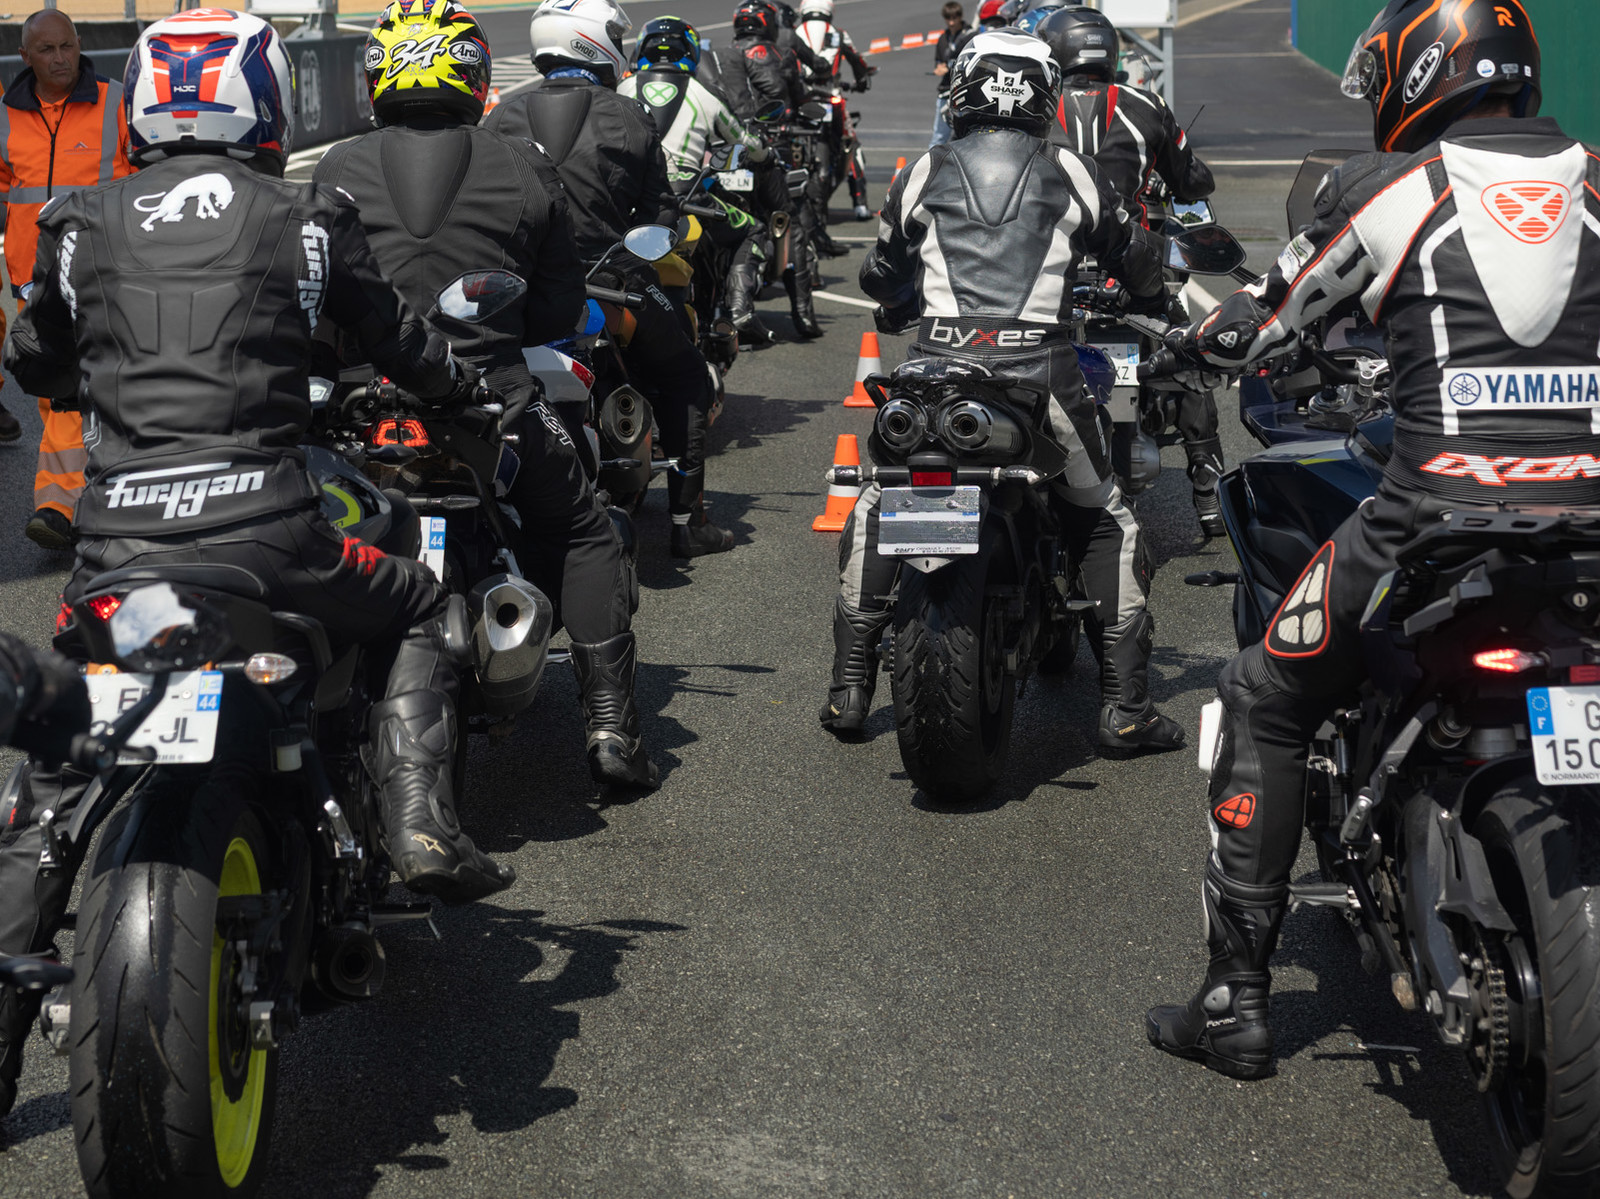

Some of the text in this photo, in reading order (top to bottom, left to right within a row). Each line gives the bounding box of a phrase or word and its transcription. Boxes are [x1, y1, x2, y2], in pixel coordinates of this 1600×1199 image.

[386, 34, 449, 79] 34
[452, 45, 479, 59] Arai
[573, 40, 596, 60] SHOEI
[1406, 49, 1437, 96] HJC
[990, 85, 1025, 96] SHARK
[929, 318, 1047, 348] byxes
[1484, 373, 1600, 404] YAMAHA
[105, 461, 266, 520] furygan
[430, 535, 444, 547] 44
[199, 695, 218, 710] 44
[1537, 716, 1546, 730] F
